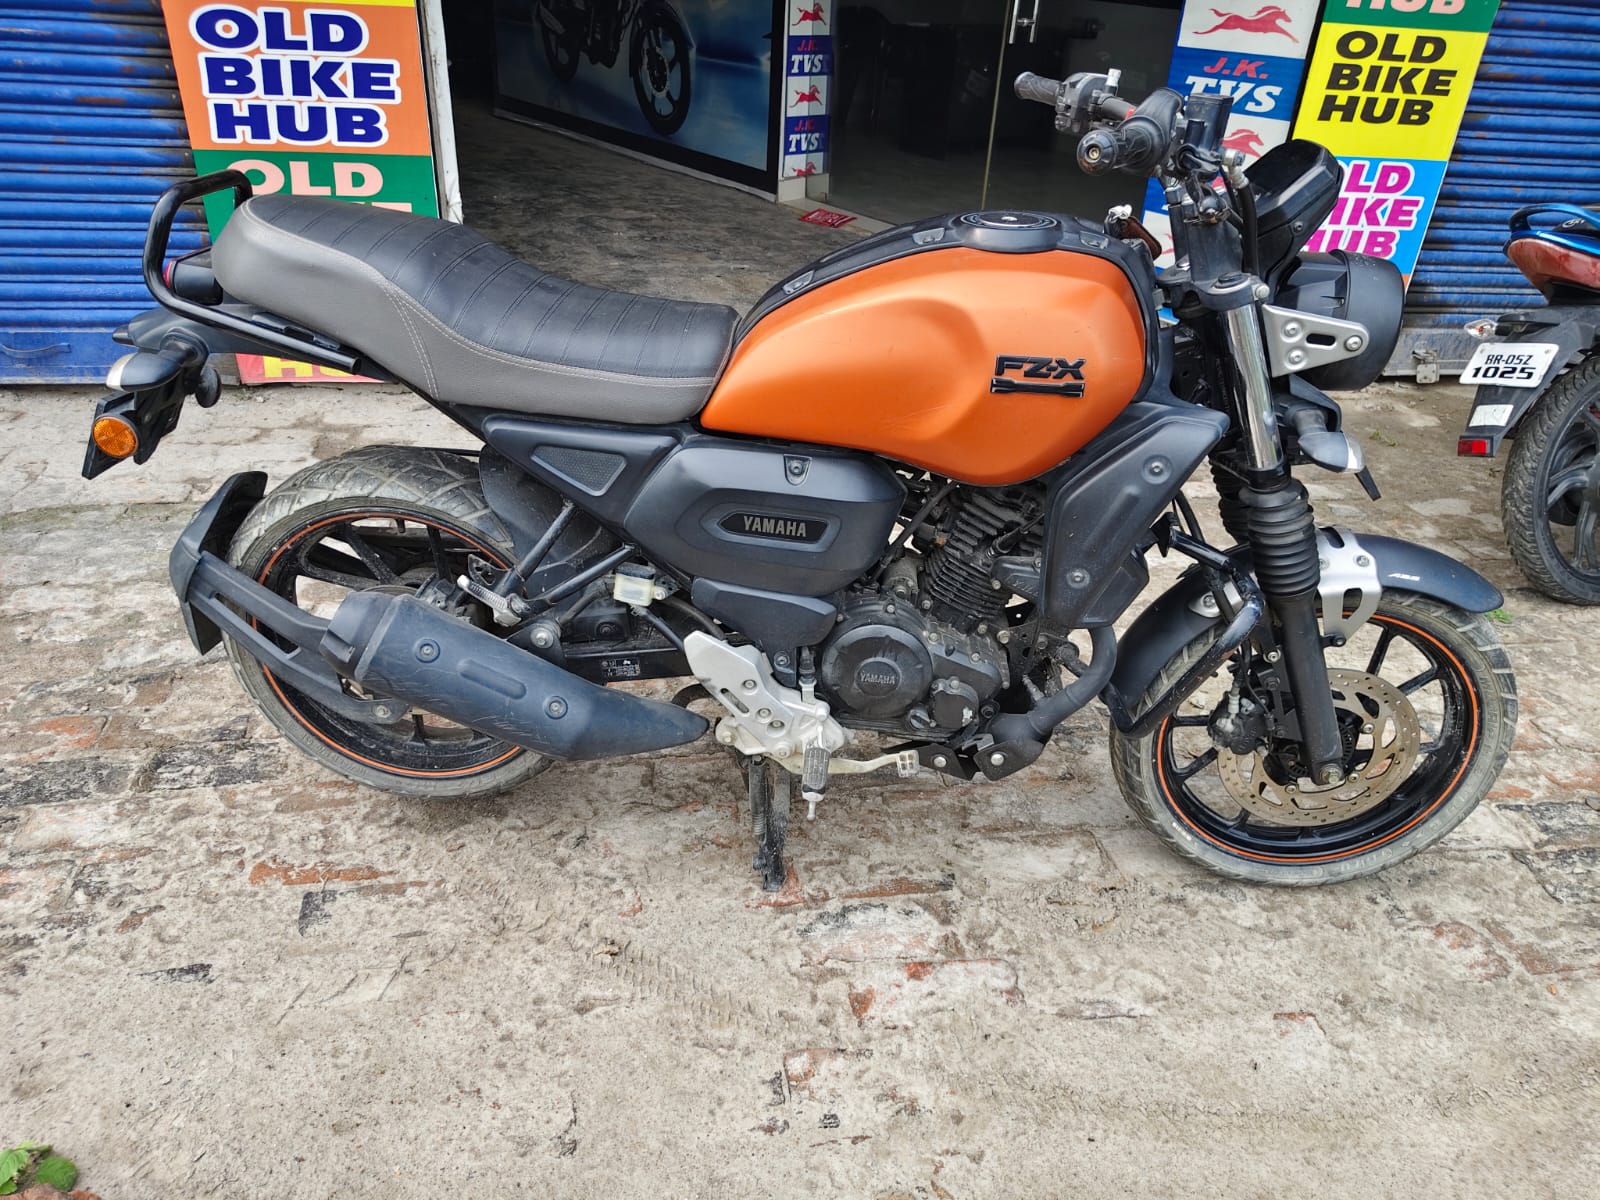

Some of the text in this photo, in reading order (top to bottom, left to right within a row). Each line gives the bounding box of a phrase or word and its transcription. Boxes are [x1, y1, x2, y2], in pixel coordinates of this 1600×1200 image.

[194, 7, 365, 54] OLD
[1334, 30, 1448, 64] OLD
[202, 55, 397, 101] BIKE
[791, 54, 823, 73] TVS
[1203, 56, 1269, 79] J.K.
[1184, 75, 1284, 113] TVS
[1324, 62, 1458, 97] BIKE
[212, 102, 385, 144] HUB
[1316, 95, 1435, 126] HUB
[788, 132, 820, 152] TVS
[226, 159, 384, 197] OLD
[1343, 163, 1412, 194] LD
[1328, 197, 1421, 228] IKE
[994, 354, 1086, 380] FZ-X
[1472, 366, 1537, 380] 1025
[743, 515, 807, 538] YAMAHA
